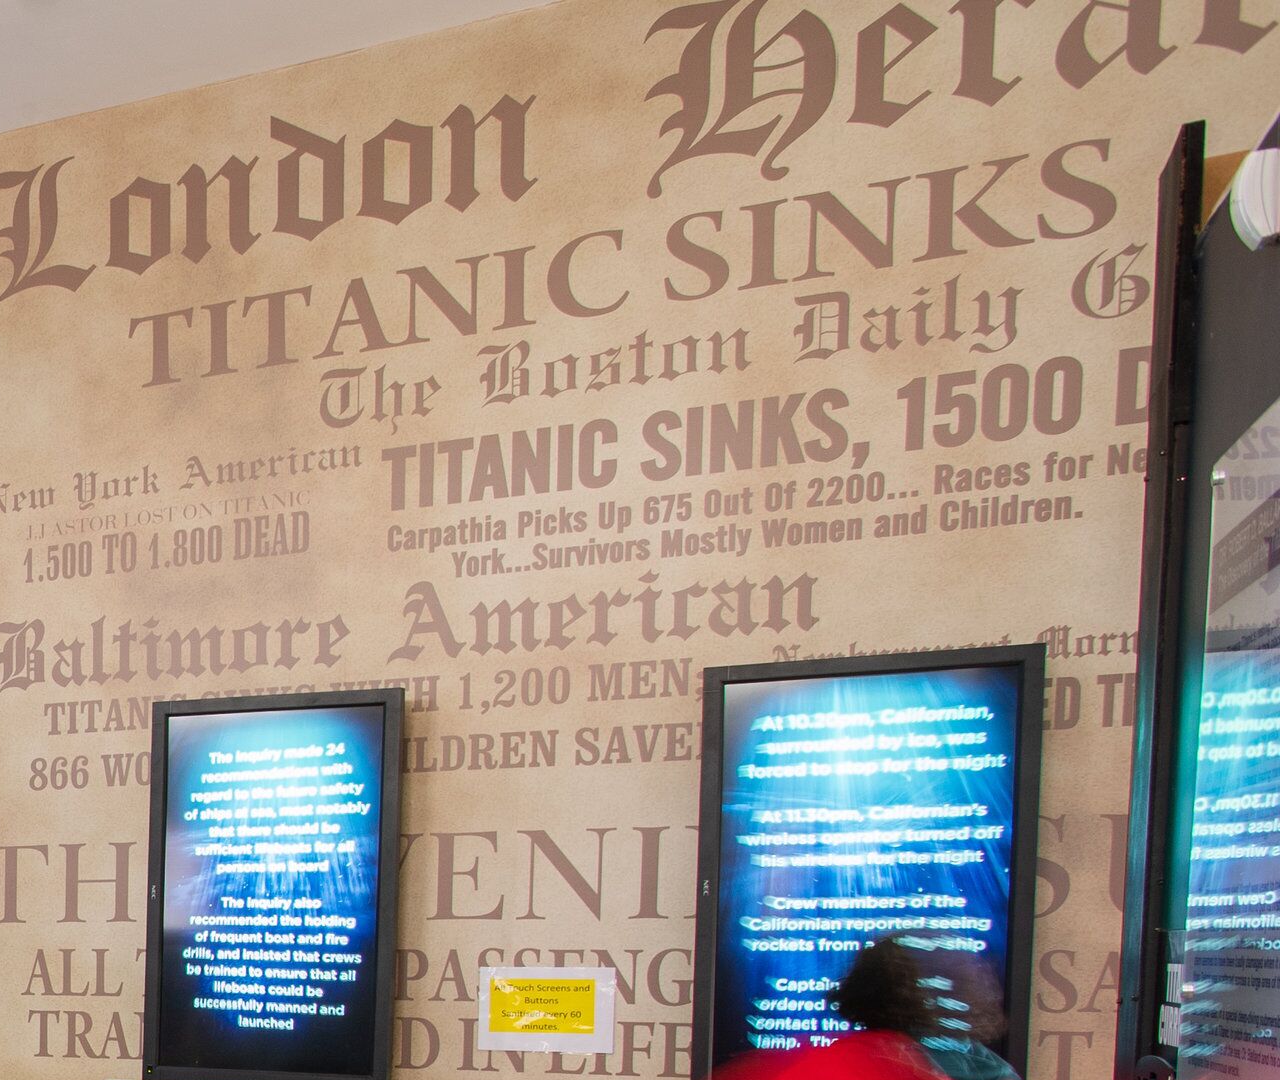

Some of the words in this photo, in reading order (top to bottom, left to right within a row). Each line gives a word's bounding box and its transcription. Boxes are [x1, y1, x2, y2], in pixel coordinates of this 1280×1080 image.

[127, 229, 630, 388] TITANIC
[664, 138, 1119, 301] SINKS
[319, 363, 442, 435] The
[477, 322, 751, 408] Boston
[793, 273, 1026, 363] Daily
[381, 418, 618, 510] TITANIC
[640, 387, 870, 481] SINKS,
[896, 355, 1083, 452] 1500
[72, 466, 160, 512] York
[178, 444, 363, 492] American
[388, 512, 507, 554] Carpathia
[518, 506, 588, 538] Picks
[599, 500, 632, 534] Up
[643, 491, 692, 524] 675
[705, 486, 753, 517] Out
[764, 480, 797, 512] Of
[806, 472, 920, 509] 2200...
[934, 459, 1031, 495] Races
[1045, 451, 1094, 483] for
[51, 514, 117, 537] ASTOR
[122, 507, 173, 528] LOST
[183, 502, 212, 524] ON
[219, 490, 312, 519] TITANIC
[661, 522, 753, 560] Mostly
[762, 515, 863, 548] Women
[874, 505, 927, 536] and
[940, 495, 1085, 533] Children.
[102, 531, 137, 575] TO
[233, 510, 311, 562] DEAD
[386, 568, 821, 665] American
[458, 666, 570, 716] 1,200
[29, 755, 89, 792] 866
[575, 722, 702, 767] SAVE
[190, 914, 277, 926] recommended
[281, 915, 302, 926] the
[305, 916, 355, 928] holding
[221, 897, 244, 908] The
[749, 917, 842, 933] Californian
[846, 917, 925, 933] reported
[929, 916, 992, 934] seeing
[773, 896, 818, 910] Crew
[822, 895, 905, 909] members
[935, 894, 967, 908] the
[21, 948, 124, 997] ALL
[214, 982, 265, 995] lifeboats
[268, 983, 304, 996] could
[306, 985, 323, 997] be
[574, 984, 590, 992] and
[239, 1016, 293, 1030] launched
